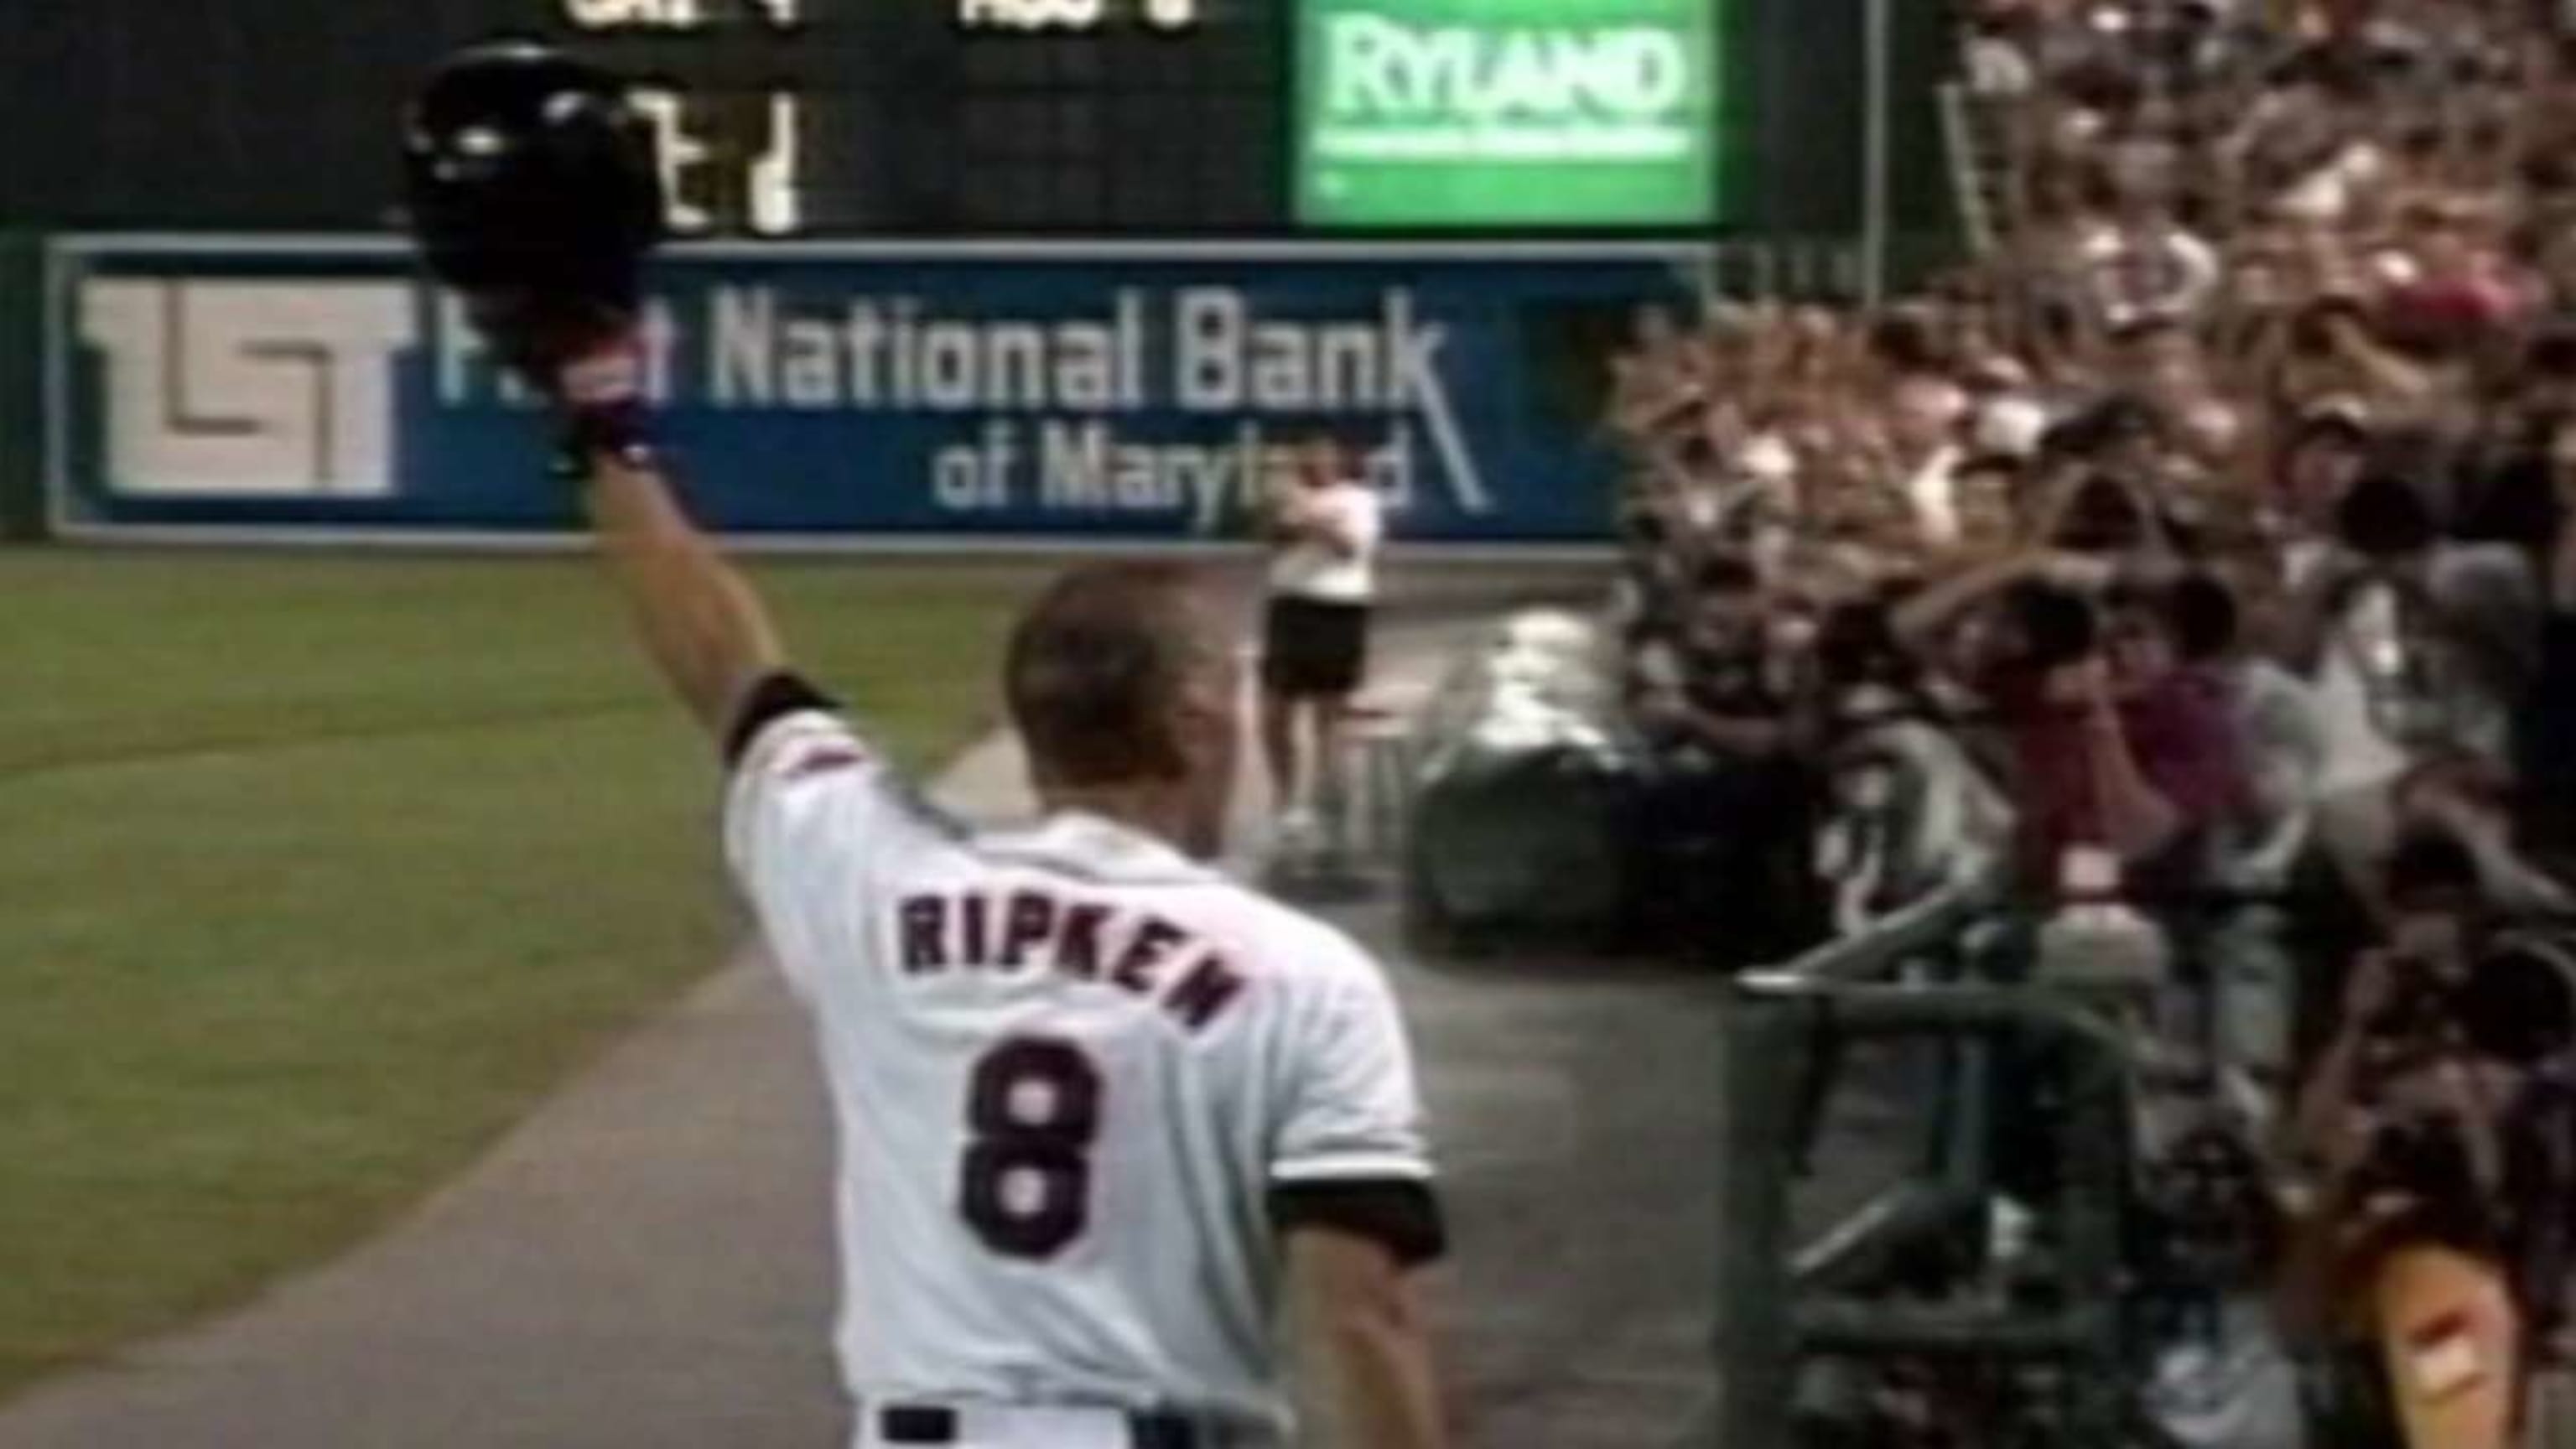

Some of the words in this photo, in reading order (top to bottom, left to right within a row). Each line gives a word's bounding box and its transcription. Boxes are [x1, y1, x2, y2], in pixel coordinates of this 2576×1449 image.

[1331, 12, 1687, 114] RYLAND
[710, 286, 1141, 408] National
[1179, 286, 1486, 509] Bank
[932, 419, 1015, 508] of
[898, 890, 1248, 1033] RIPKEN
[959, 1037, 1104, 1261] 8
